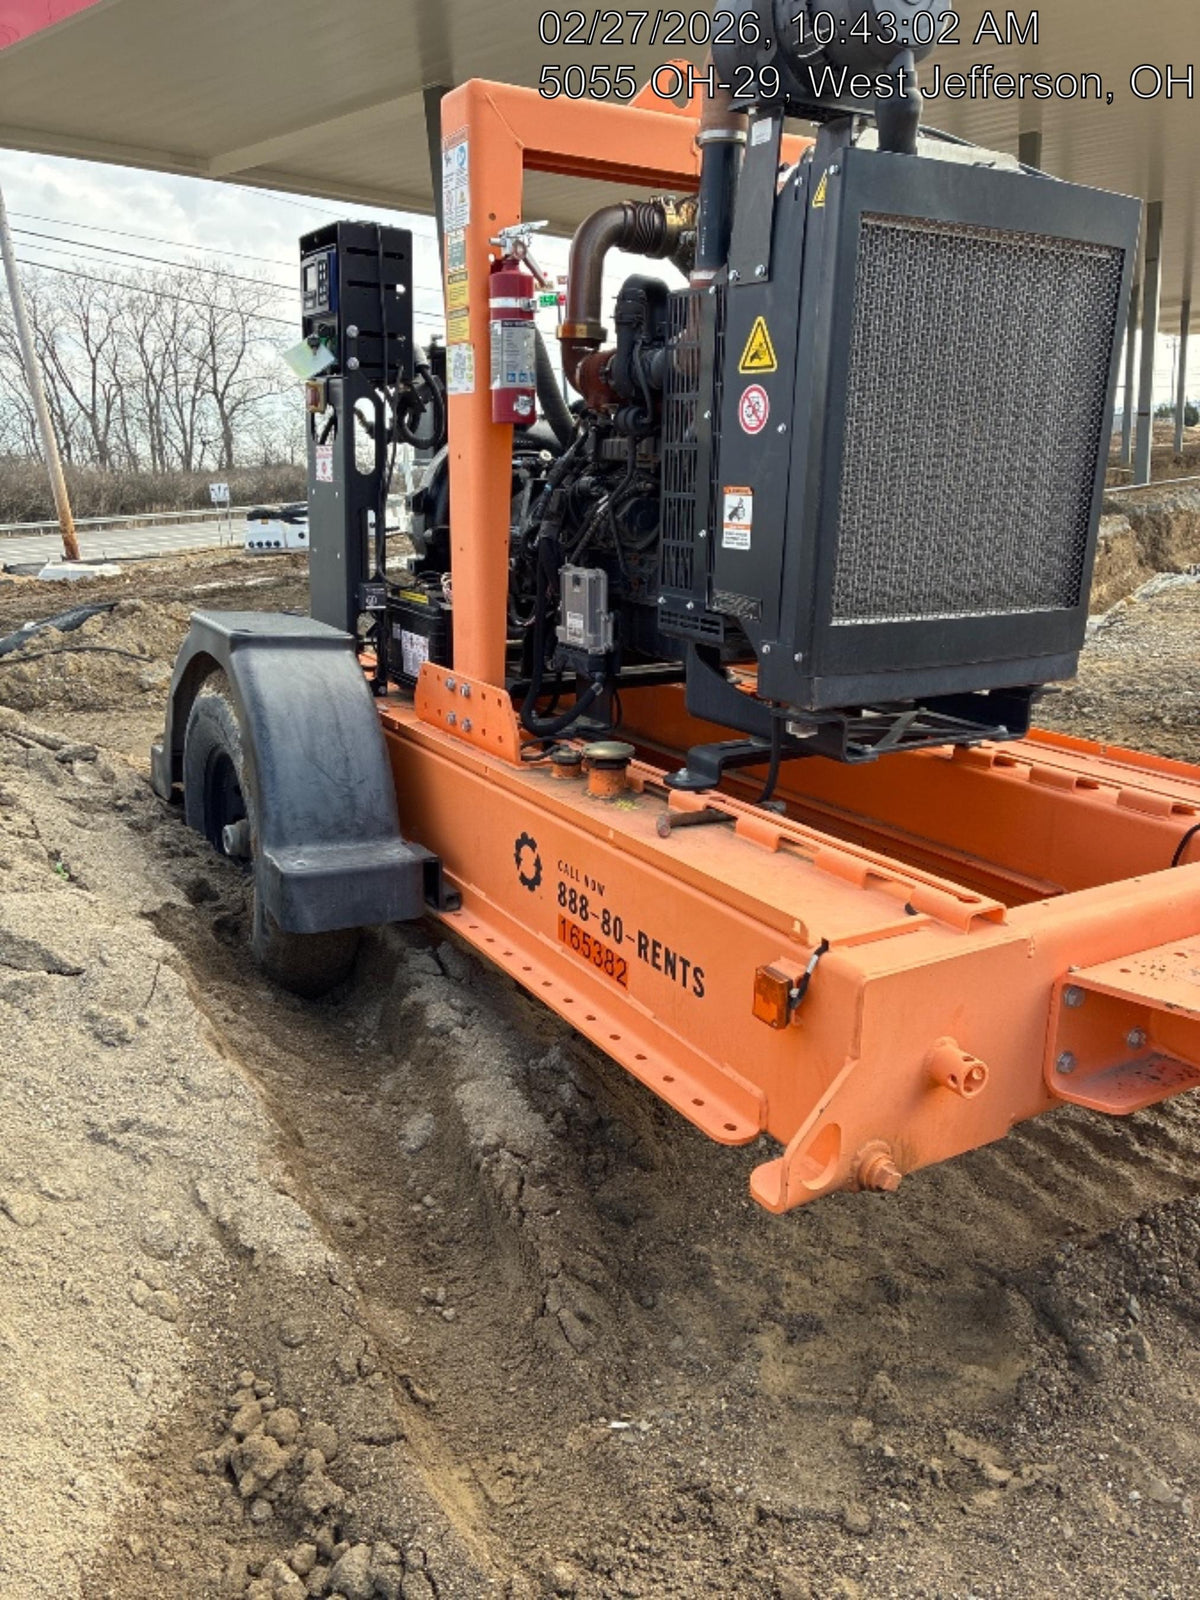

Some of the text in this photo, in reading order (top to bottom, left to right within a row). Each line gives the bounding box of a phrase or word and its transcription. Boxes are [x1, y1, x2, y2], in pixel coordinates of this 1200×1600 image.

[557, 860, 606, 897] CALL NOW
[557, 881, 705, 998] 888-80-RENTS
[560, 918, 629, 988] 165382
